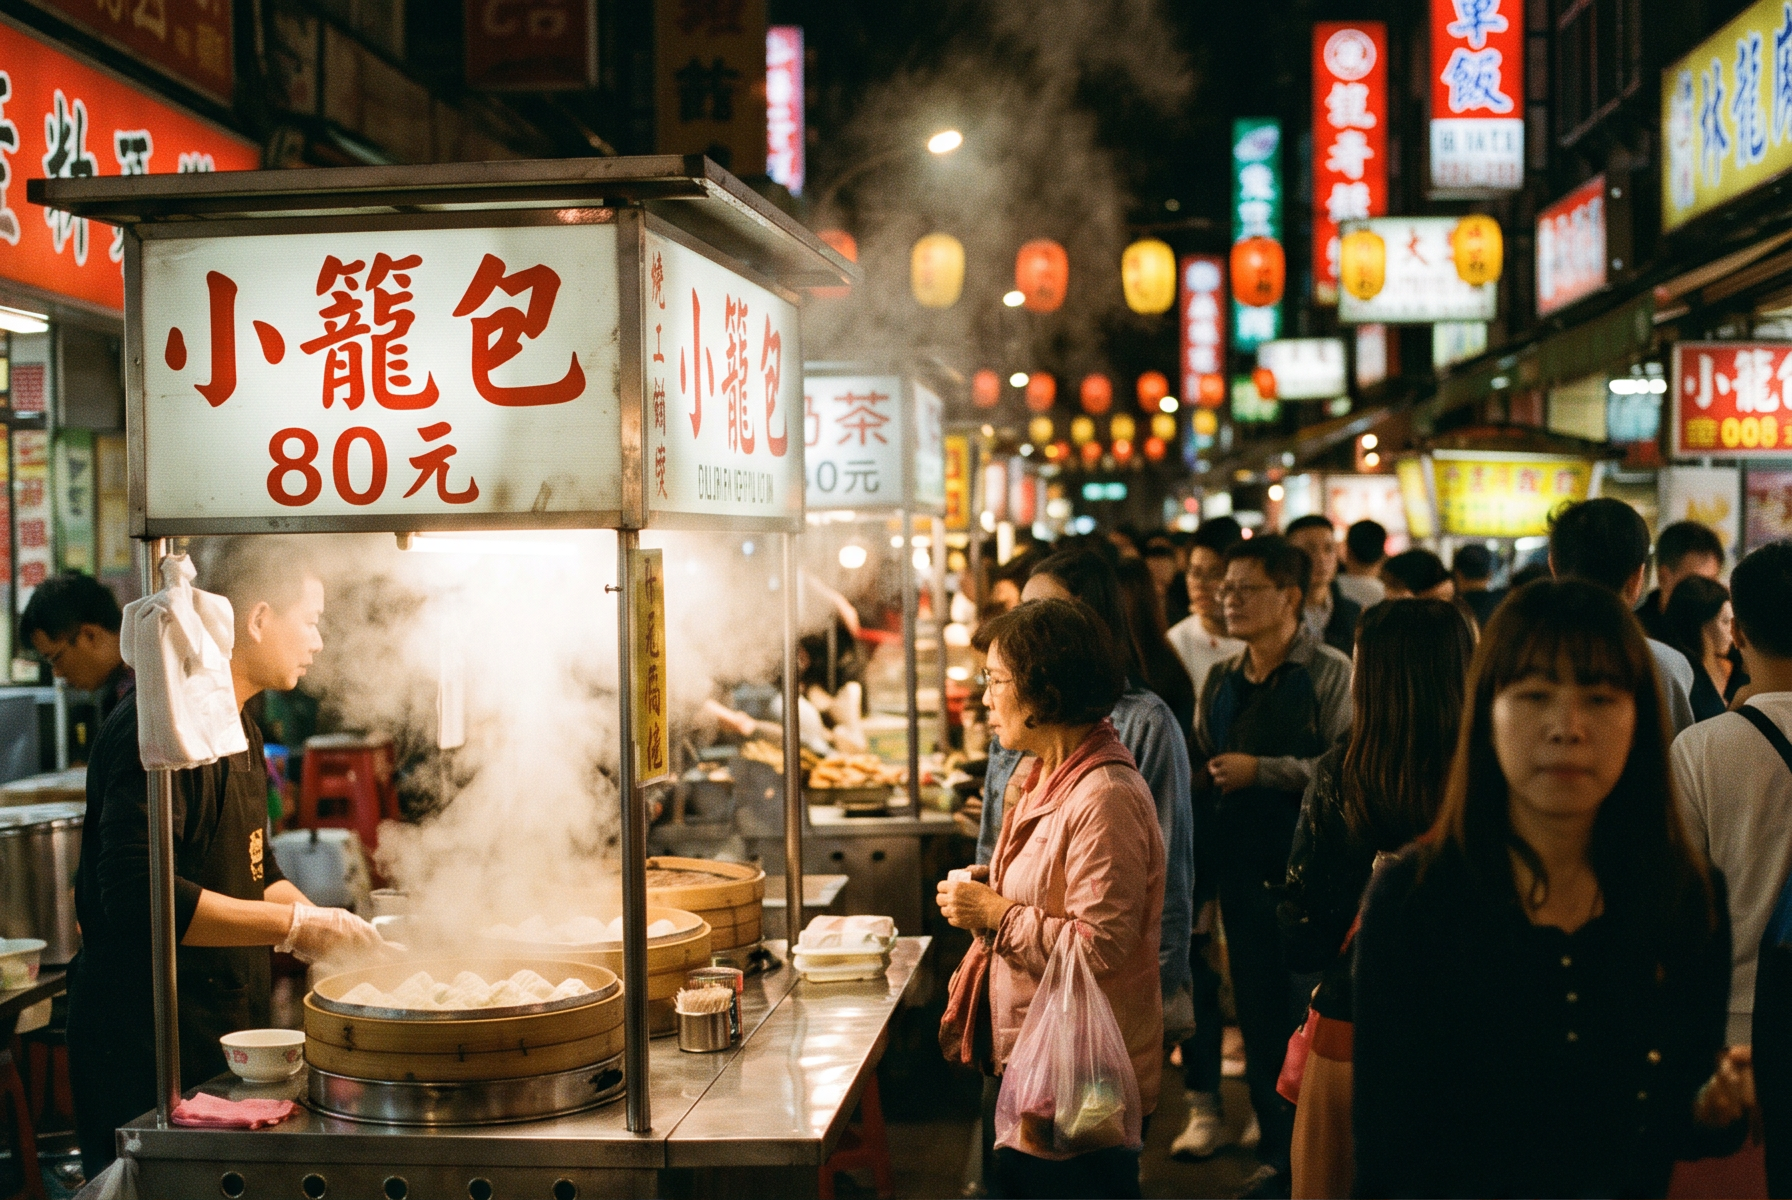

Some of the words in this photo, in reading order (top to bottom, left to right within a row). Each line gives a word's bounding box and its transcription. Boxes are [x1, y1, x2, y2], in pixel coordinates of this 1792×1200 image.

[166, 253, 586, 410] 小籠包
[680, 286, 788, 457] 小籠包
[267, 422, 479, 506] 80元
[804, 460, 880, 493] 0元
